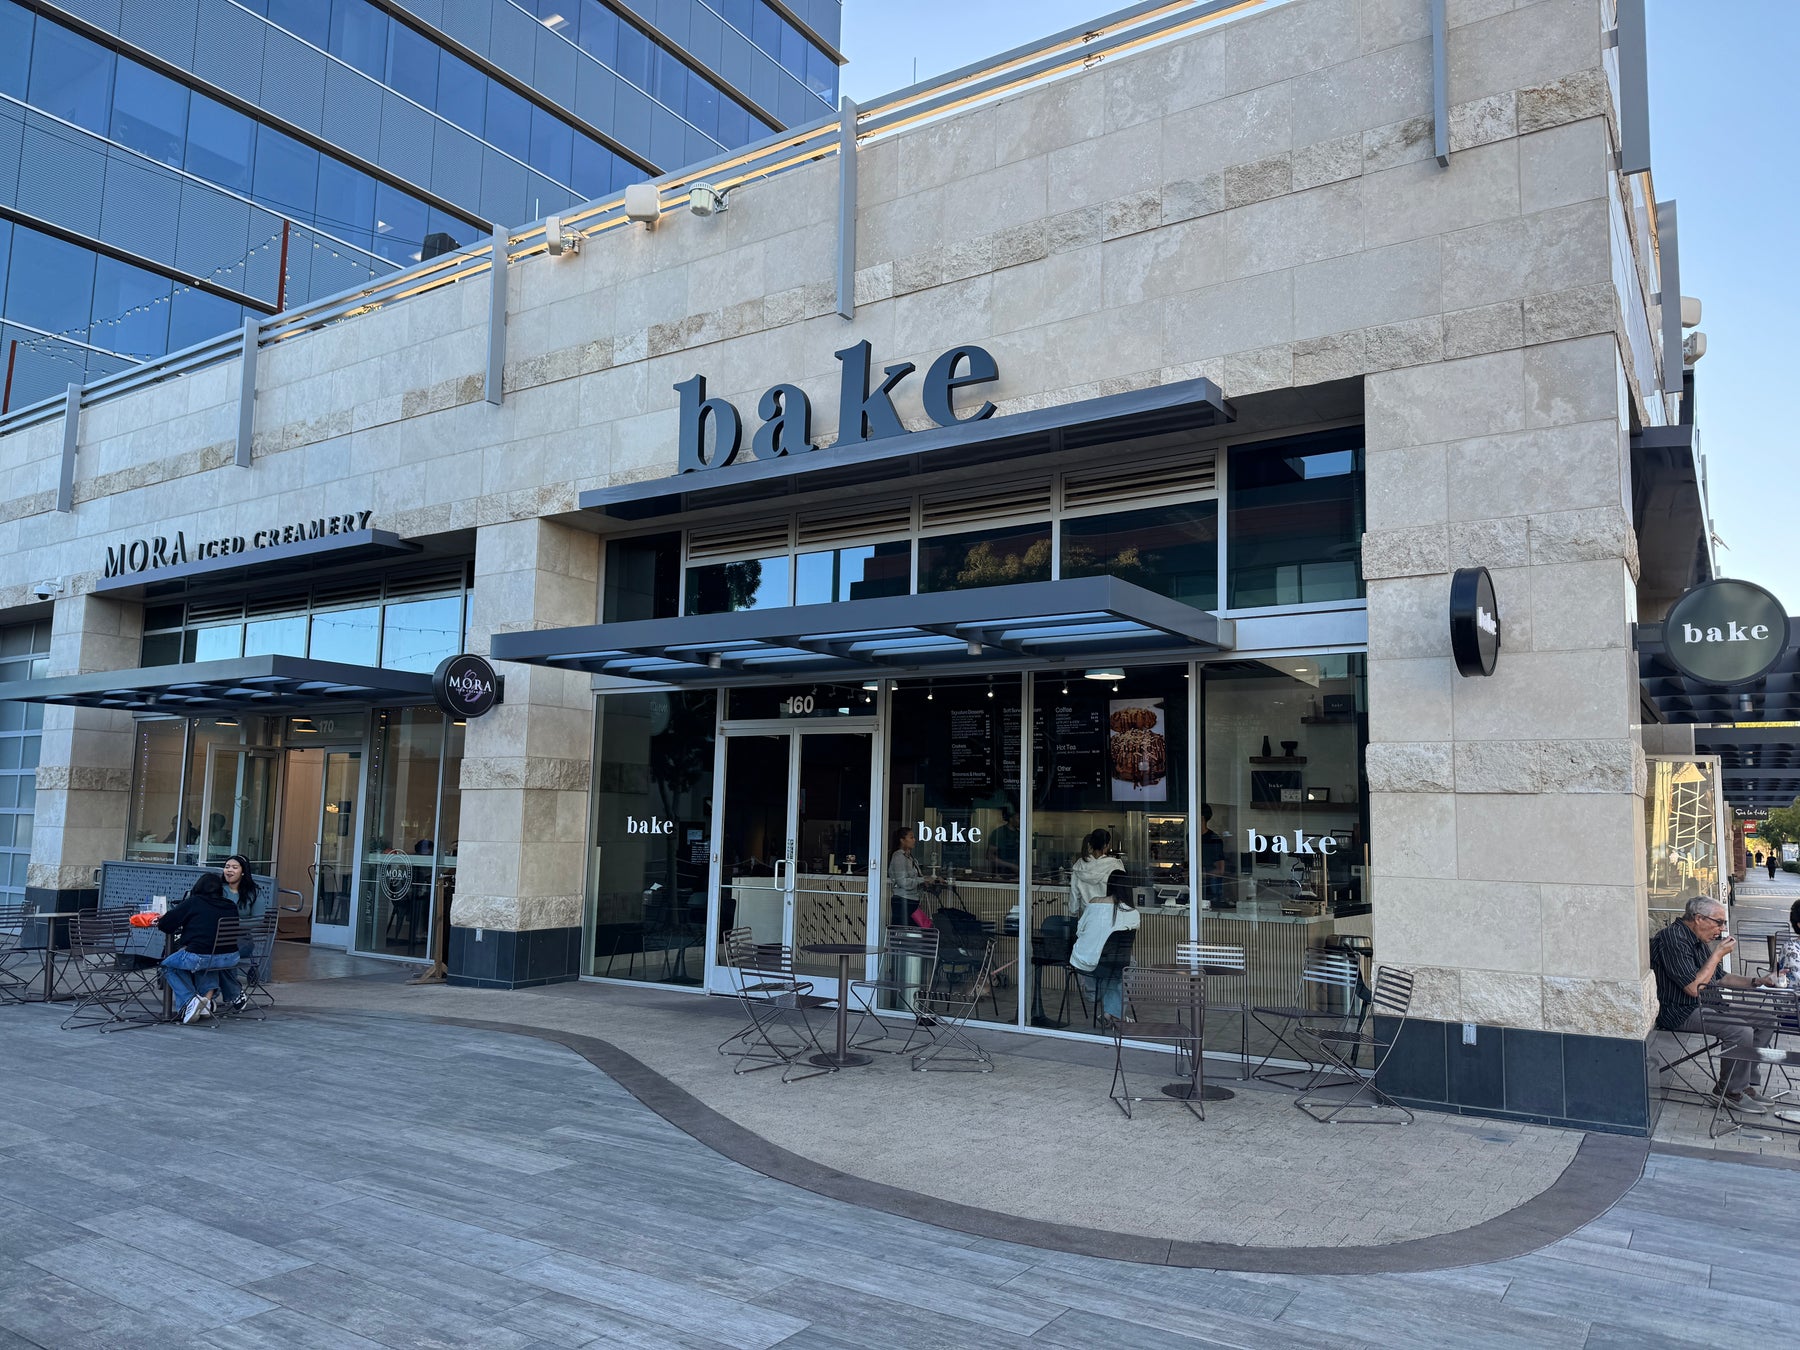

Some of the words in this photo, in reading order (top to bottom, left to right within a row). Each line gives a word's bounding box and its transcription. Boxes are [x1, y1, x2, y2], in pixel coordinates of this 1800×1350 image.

[673, 339, 999, 477] bake
[104, 530, 187, 578] MORA
[198, 536, 245, 561] ICED
[253, 510, 373, 550] CREAMERY
[1682, 620, 1769, 645] bake
[448, 675, 492, 693] MORA
[786, 695, 815, 714] 160
[319, 719, 334, 733] 170
[627, 816, 674, 834] bake
[918, 821, 982, 843] bake
[1246, 828, 1337, 855] bake
[386, 869, 407, 879] MORA
